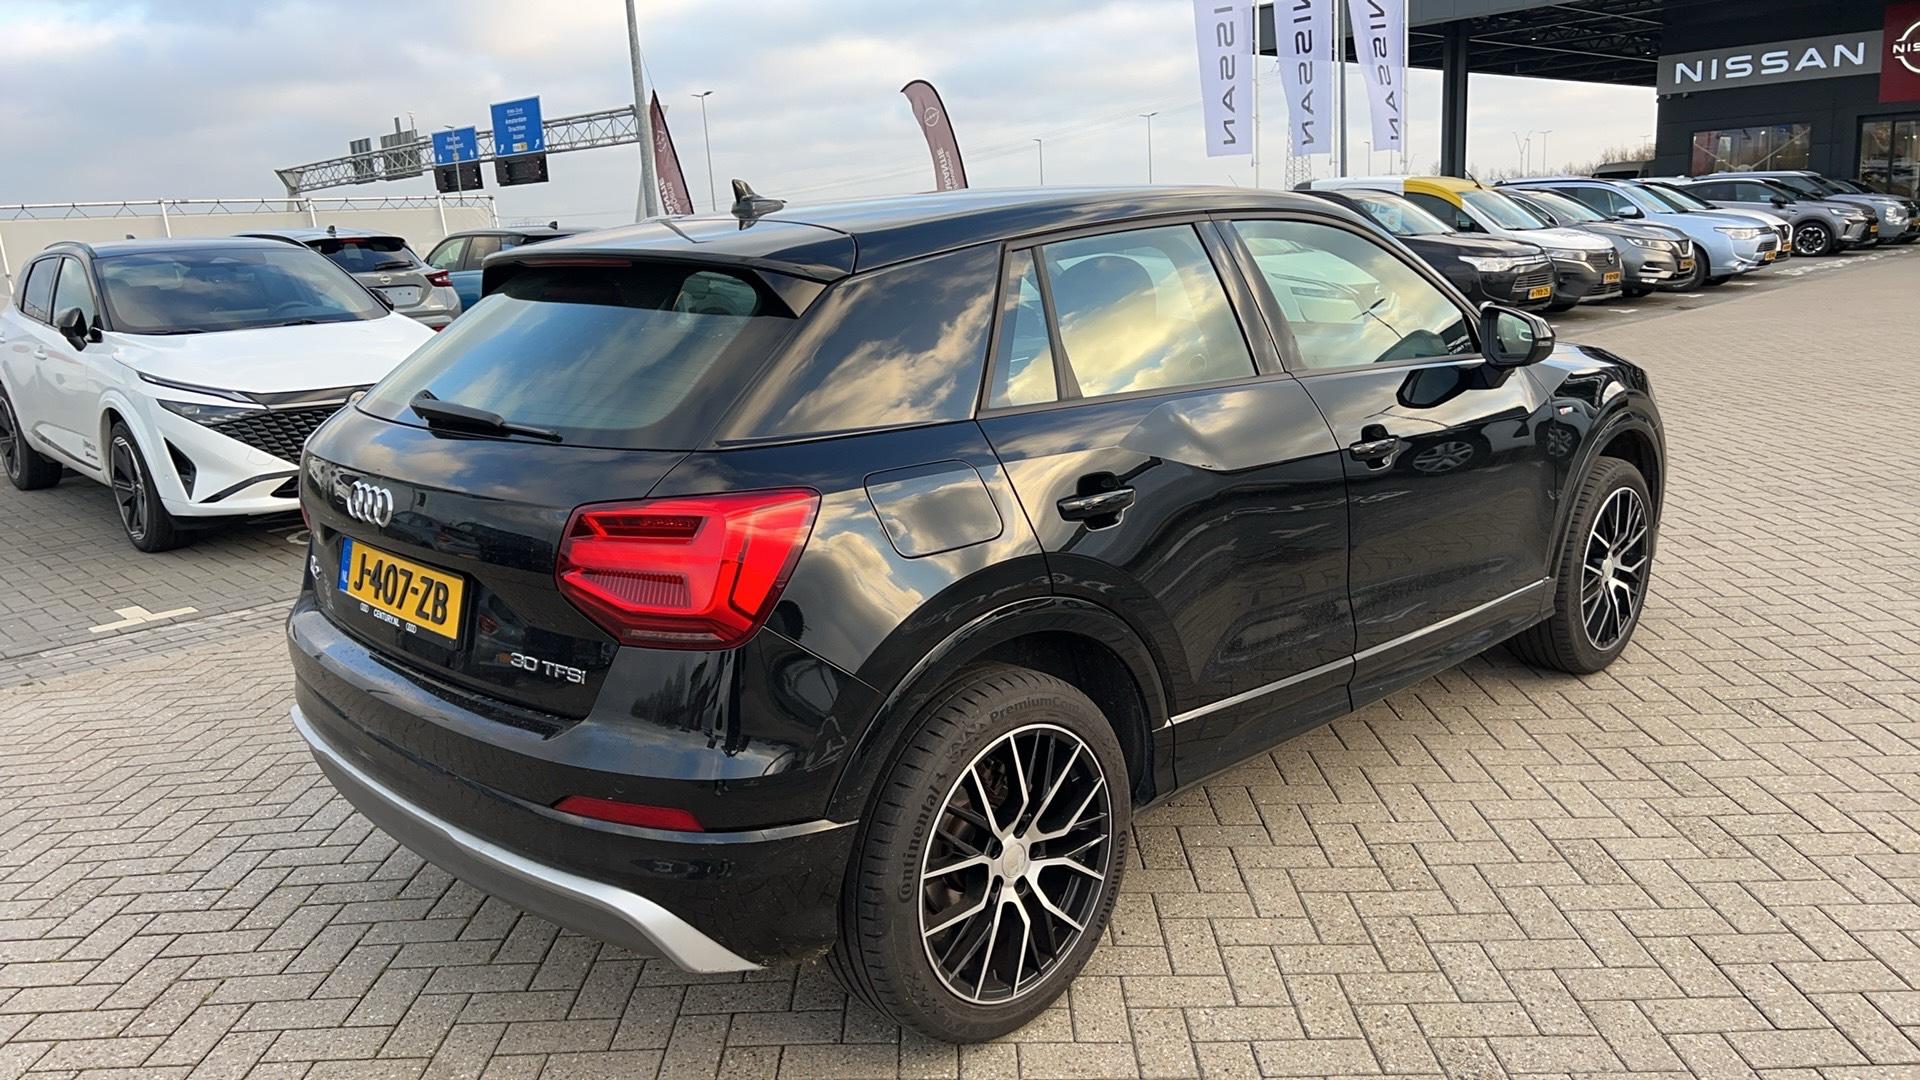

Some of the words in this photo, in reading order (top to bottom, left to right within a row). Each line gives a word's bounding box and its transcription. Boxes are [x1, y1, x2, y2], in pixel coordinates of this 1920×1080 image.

[1675, 42, 1865, 84] NISSAN
[1892, 42, 1920, 54] NIS
[353, 552, 450, 626] J-407-ZB
[510, 652, 539, 672] 30
[541, 660, 587, 685] TFSI
[897, 784, 941, 903] Continental
